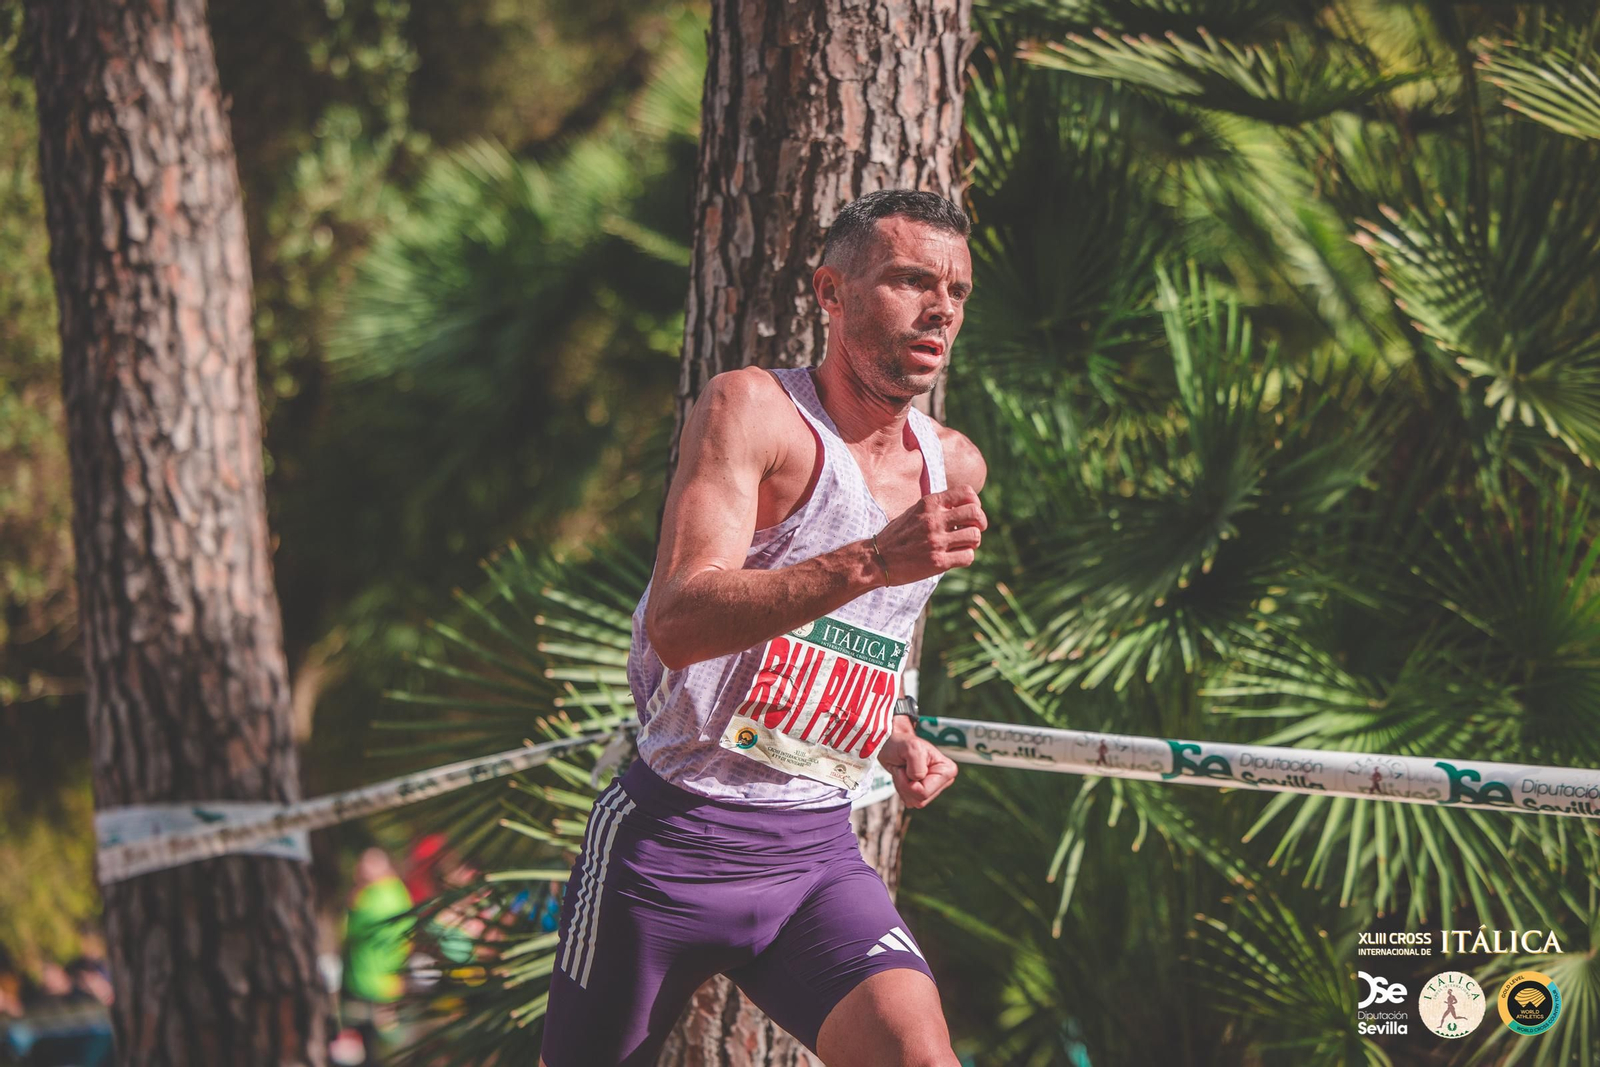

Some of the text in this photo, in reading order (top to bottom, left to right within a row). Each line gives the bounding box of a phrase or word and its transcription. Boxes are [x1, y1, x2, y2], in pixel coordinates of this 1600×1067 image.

[822, 623, 886, 661] ITÁLICA
[738, 637, 895, 759] RUI PINTO
[1239, 752, 1324, 774] Diputación
[1521, 778, 1600, 800] Diputació
